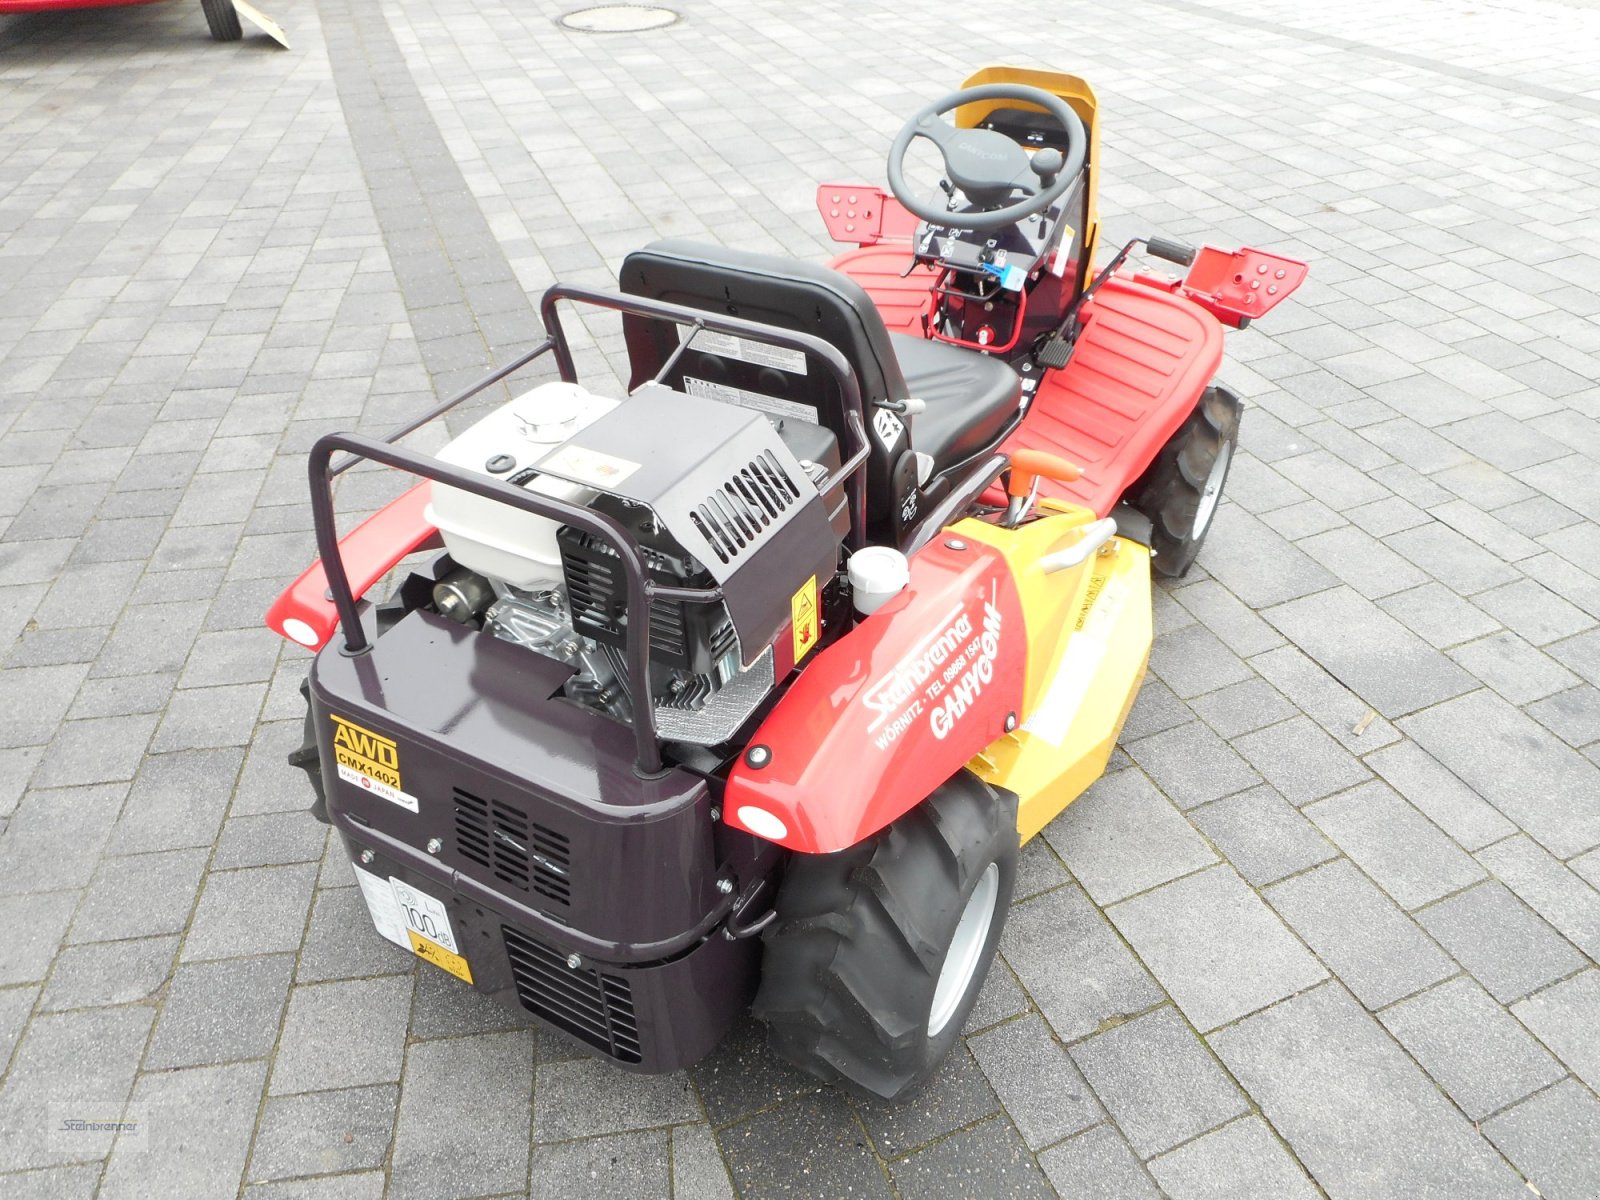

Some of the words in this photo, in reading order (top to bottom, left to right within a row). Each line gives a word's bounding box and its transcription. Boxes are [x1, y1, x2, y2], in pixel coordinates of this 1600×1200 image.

[875, 699, 924, 750] WÖRNITZ
[925, 680, 946, 700] TEL
[334, 723, 399, 770] AWD
[338, 752, 399, 788] CMX1402
[401, 903, 437, 939] 100
